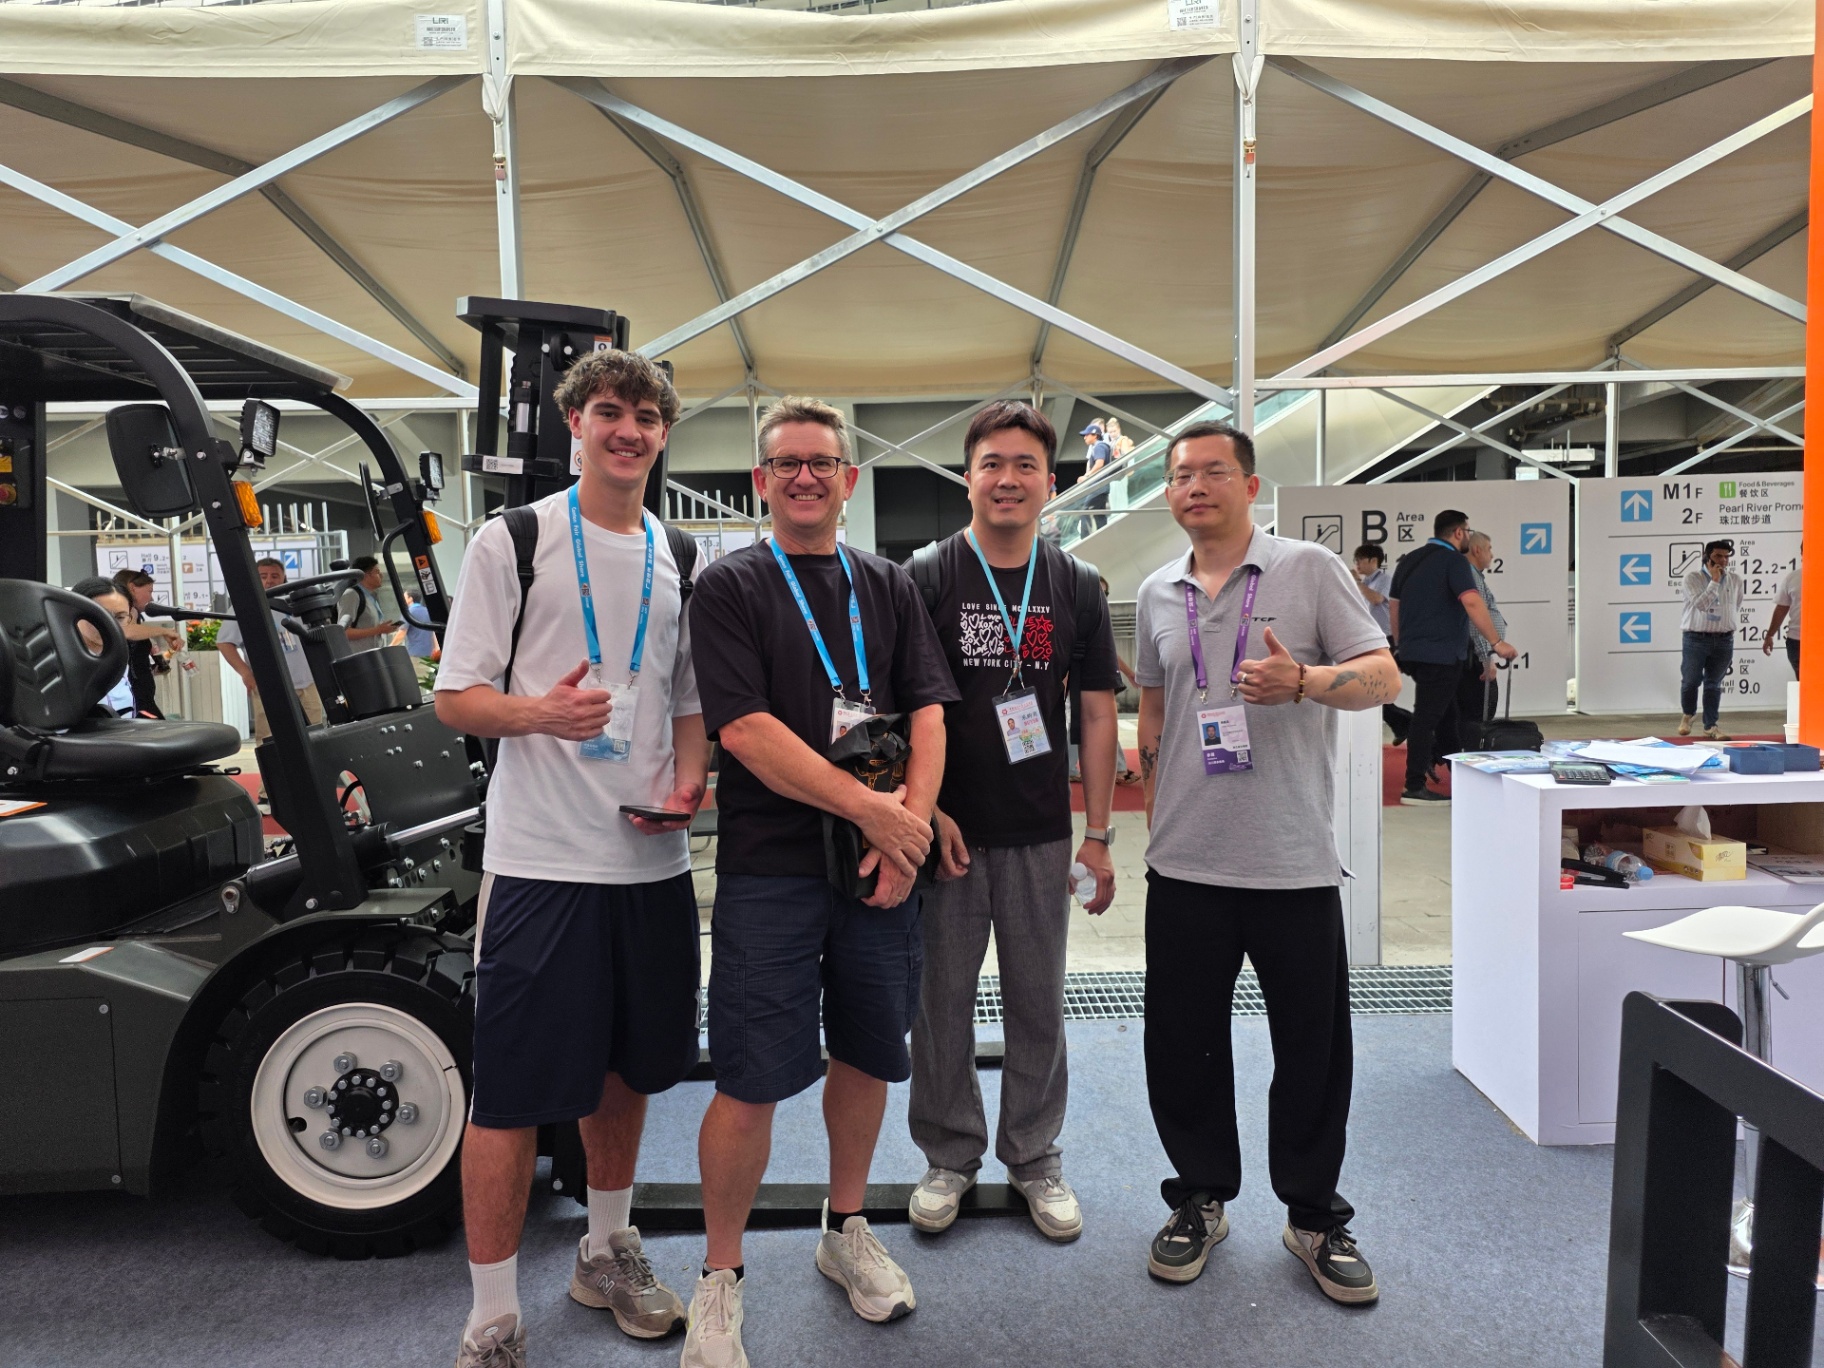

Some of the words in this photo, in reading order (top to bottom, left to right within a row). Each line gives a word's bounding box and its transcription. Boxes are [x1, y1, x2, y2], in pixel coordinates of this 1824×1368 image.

[1739, 488, 1769, 498] 餐饮区
[1719, 503, 1744, 513] Pearl
[1746, 503, 1773, 512] River
[1396, 512, 1425, 521] Area
[1720, 514, 1771, 525] 珠江散步道
[1361, 510, 1388, 545] B
[1398, 524, 1415, 542] 区
[1740, 546, 1750, 556] 区
[1012, 604, 1050, 614] MCLXXXV
[1740, 614, 1750, 623] 区
[963, 658, 980, 667] NEW
[982, 659, 1001, 668] YORK
[1740, 665, 1750, 675] 区
[1739, 679, 1761, 694] 9.0
